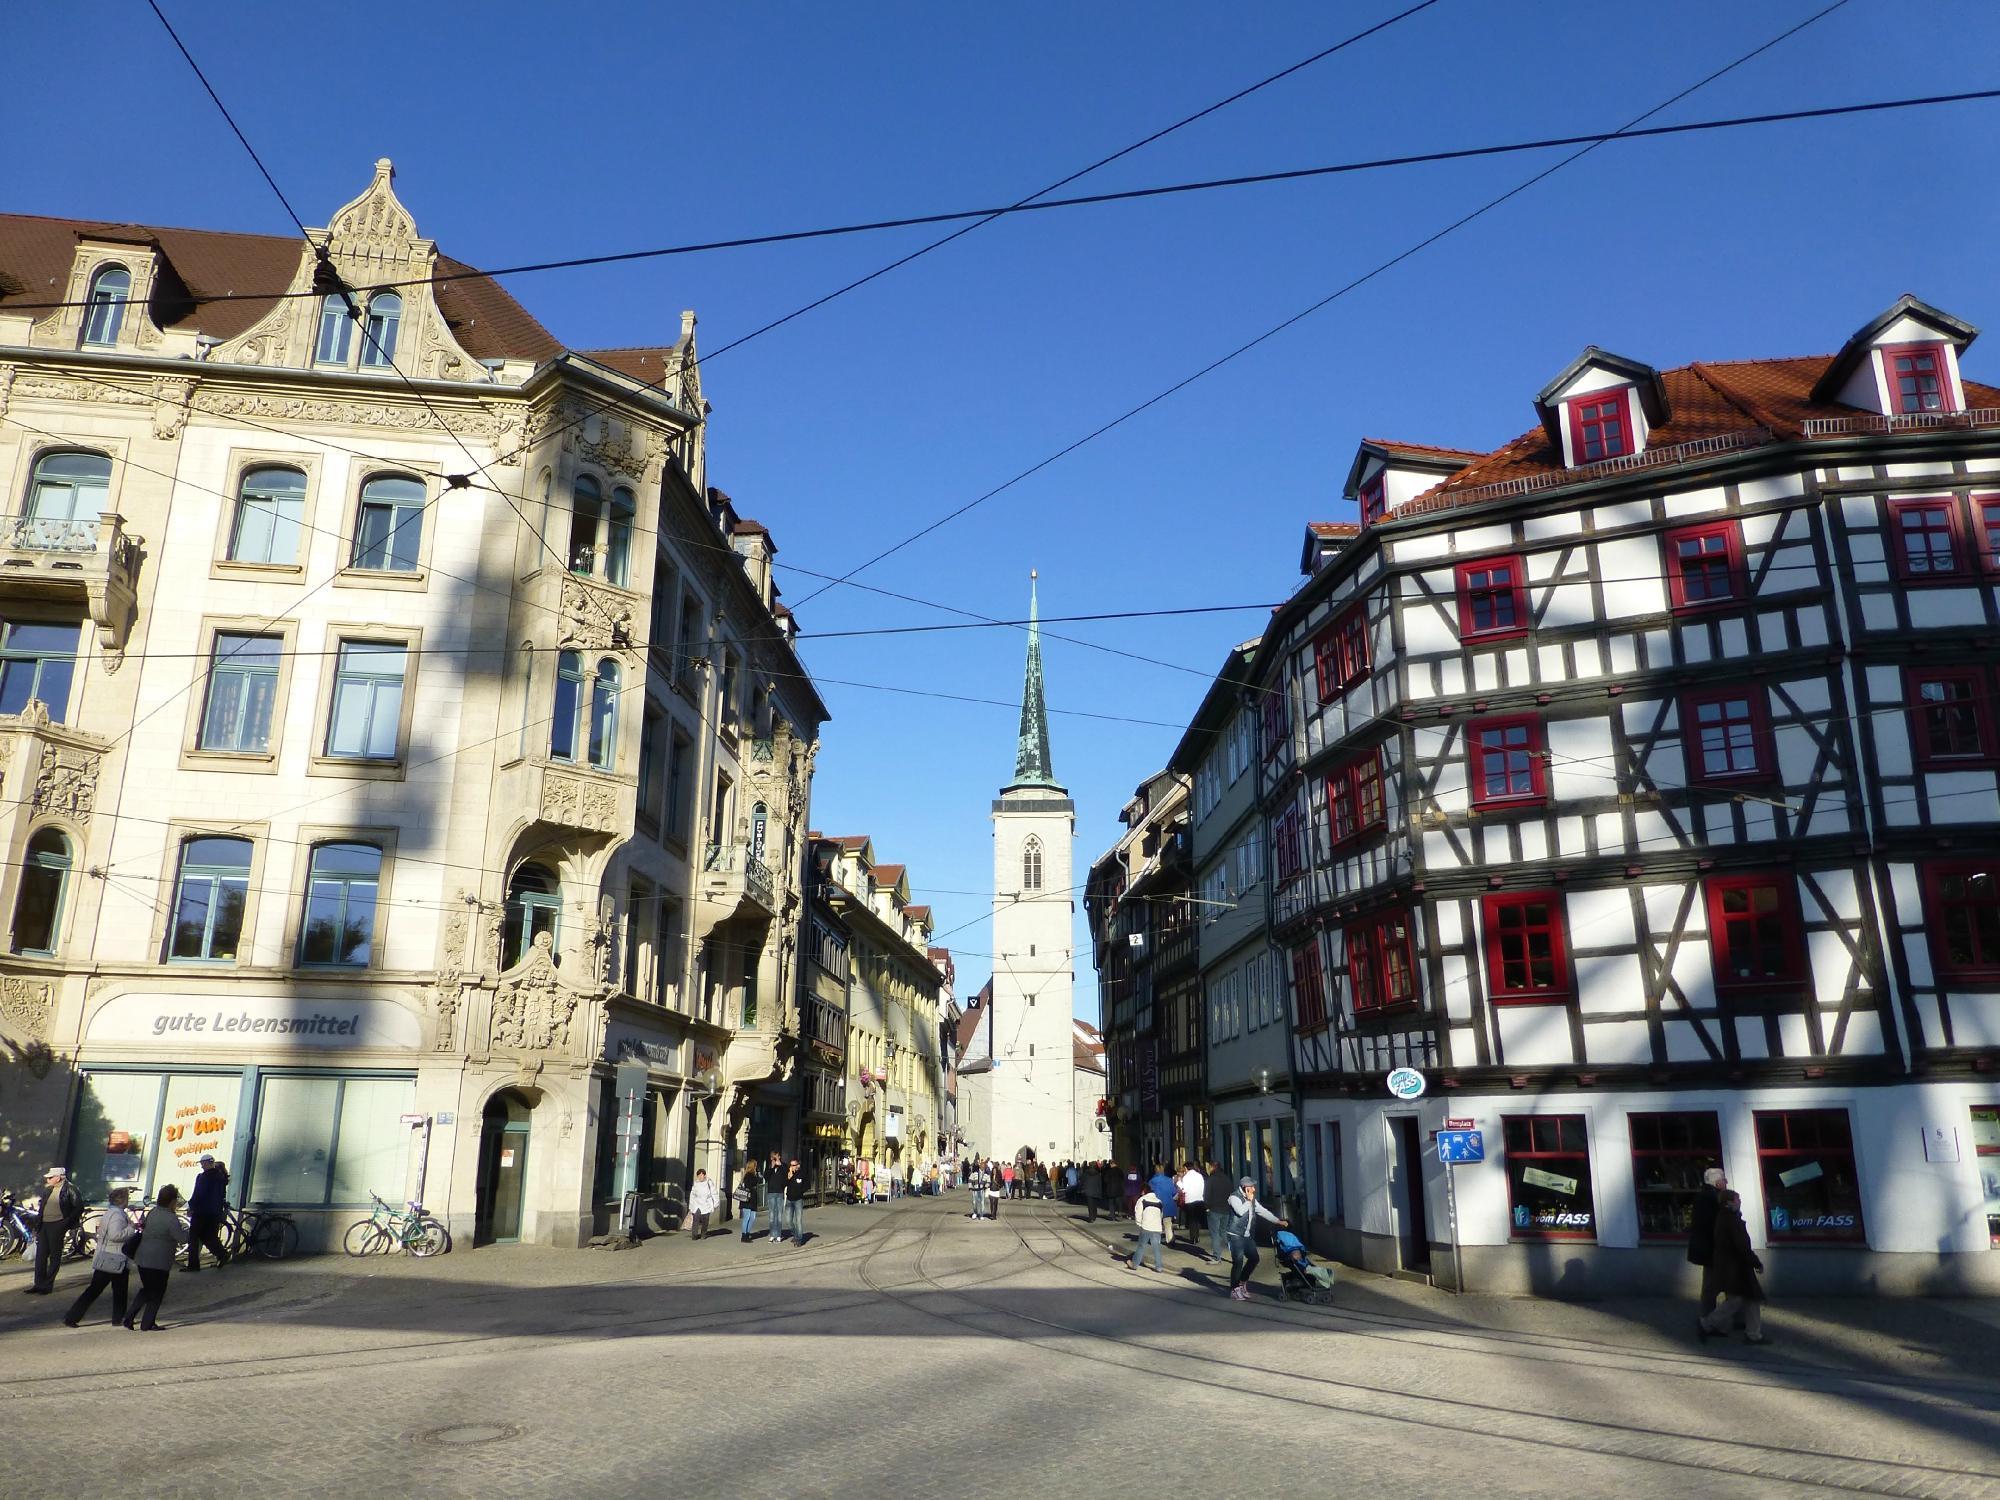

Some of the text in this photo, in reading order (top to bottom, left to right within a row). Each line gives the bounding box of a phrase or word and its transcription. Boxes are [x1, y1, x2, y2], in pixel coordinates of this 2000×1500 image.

[152, 1012, 359, 1035] gute Lebensmittel
[1535, 1213, 1590, 1225] vom FASS
[1792, 1215, 1854, 1226] vom FASS
